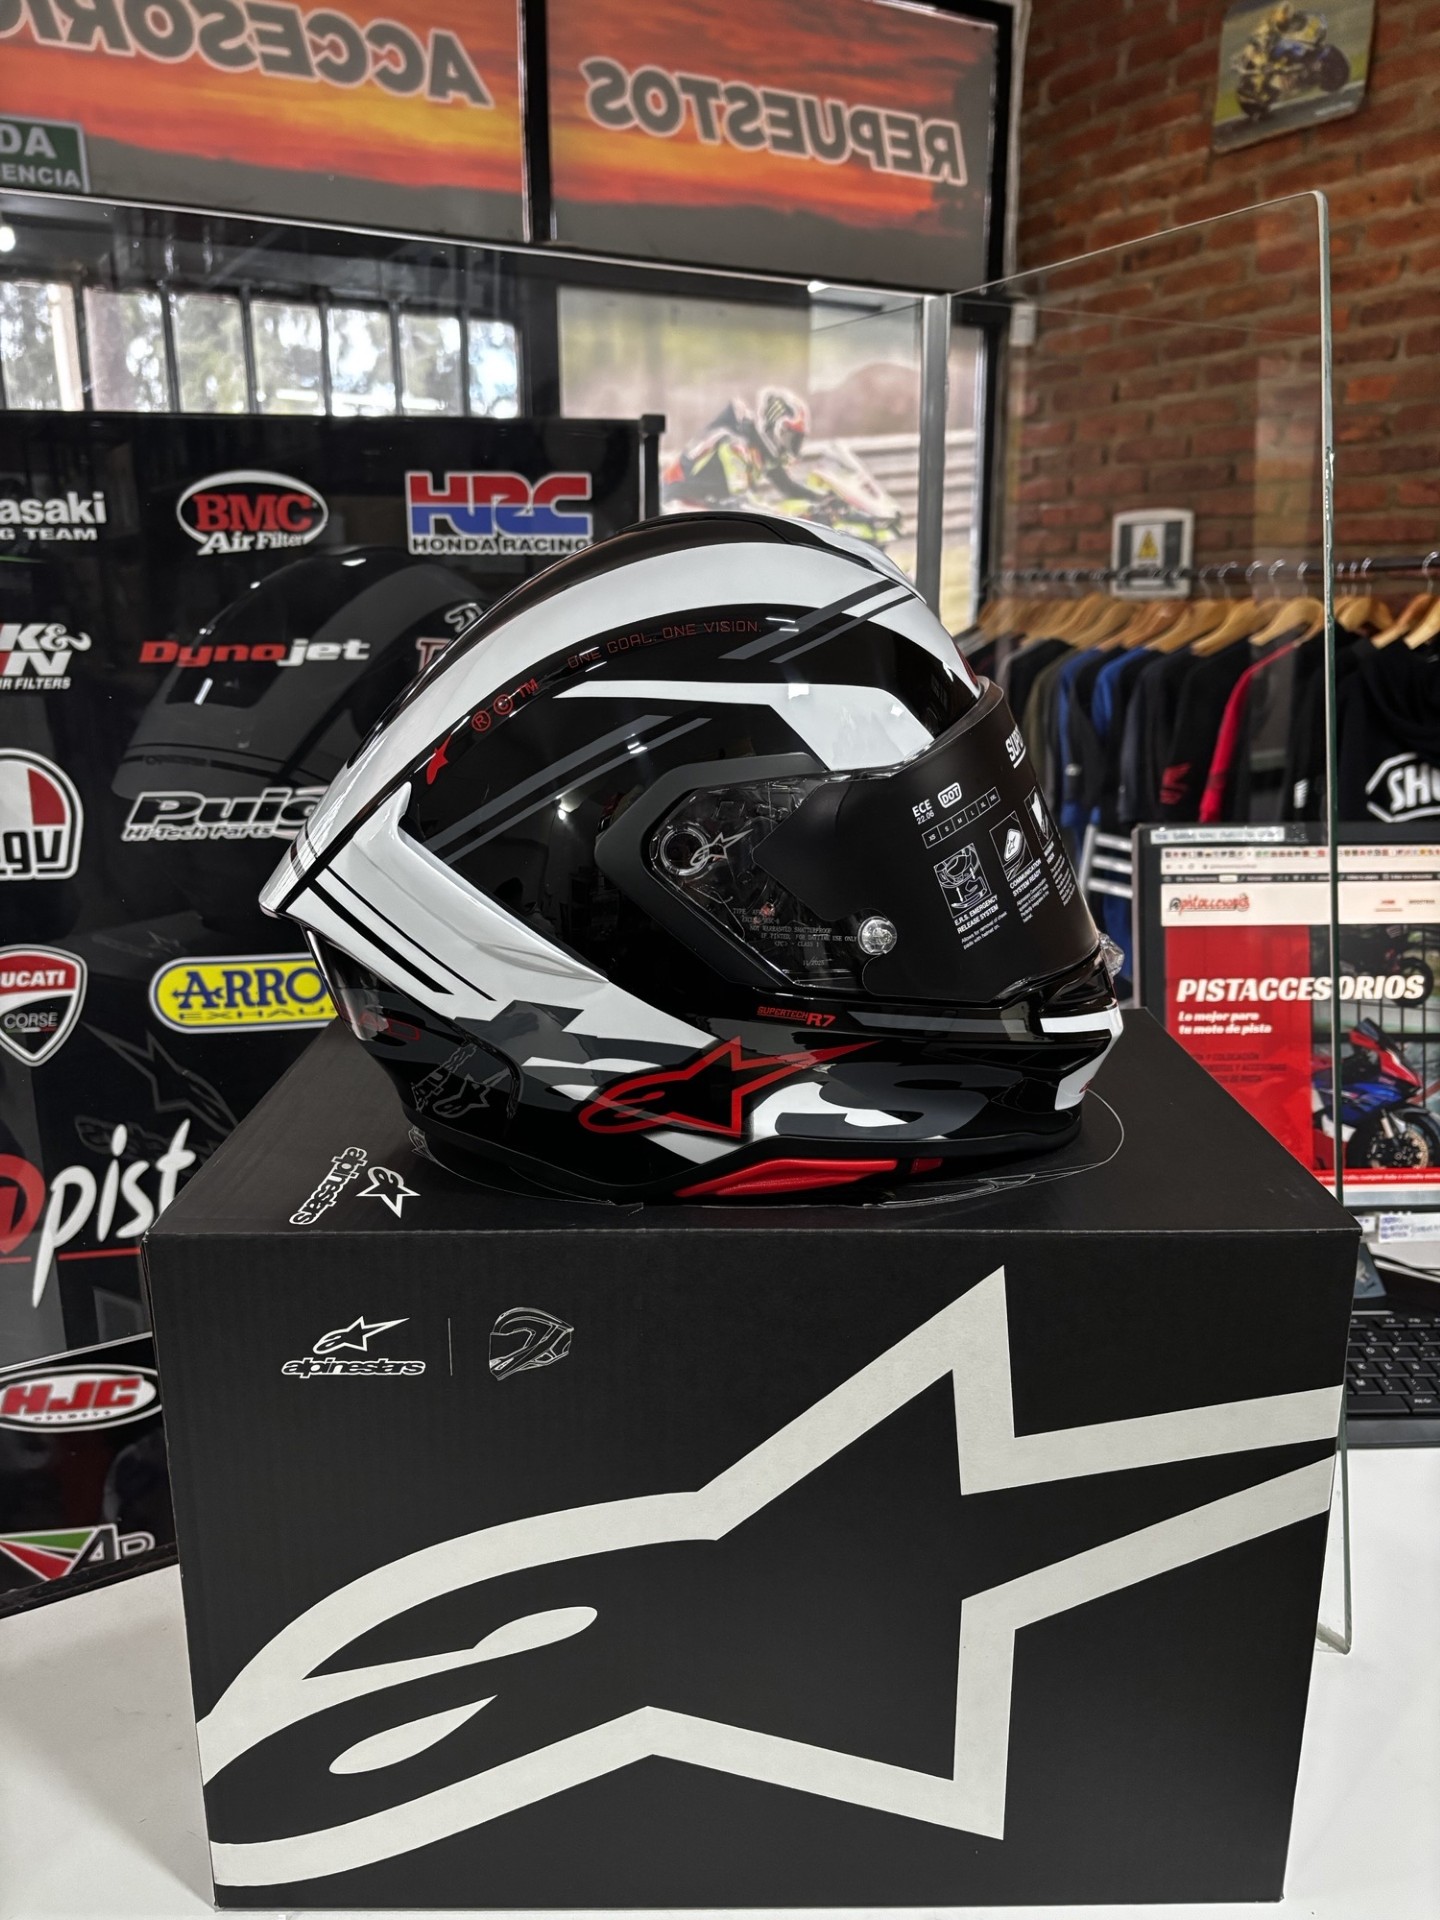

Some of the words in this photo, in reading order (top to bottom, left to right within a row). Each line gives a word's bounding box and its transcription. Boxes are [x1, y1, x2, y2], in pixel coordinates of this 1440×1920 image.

[2, 164, 82, 188] ENCIA
[193, 494, 314, 532] BMC
[405, 471, 593, 536] HRC
[23, 528, 98, 540] TEAM
[197, 531, 254, 555] Air
[255, 533, 305, 549] Filter
[409, 534, 496, 553] HONDA
[139, 638, 370, 668] Dynojet
[568, 650, 602, 669] ONE
[607, 633, 657, 654] GOAL.
[662, 623, 697, 640] ONE
[703, 620, 762, 633] VISION.
[14, 677, 72, 690] FILTERS
[941, 786, 960, 804] DOT
[912, 799, 932, 818] ECE
[916, 809, 935, 825] 22.06
[208, 824, 274, 841] Parts
[1010, 858, 1041, 889] COMMUNICATION
[1012, 879, 1030, 897] SYSTEM
[1029, 868, 1041, 883] READY
[969, 894, 998, 917] EMERGENCY
[957, 916, 980, 934] RELEASE
[980, 904, 999, 920] SYSTEM
[1, 970, 66, 988] UCATI
[4, 1012, 58, 1028] CORSE
[757, 1006, 808, 1020] SUPERTECH
[806, 1013, 836, 1027] R7
[1194, 1011, 1230, 1023] mejor
[1230, 1012, 1259, 1024] para
[1193, 1025, 1225, 1034] moto
[1225, 1024, 1241, 1034] de
[1241, 1023, 1272, 1036] pista
[281, 1357, 426, 1378] alpinestars
[1, 1377, 141, 1415] HJC
